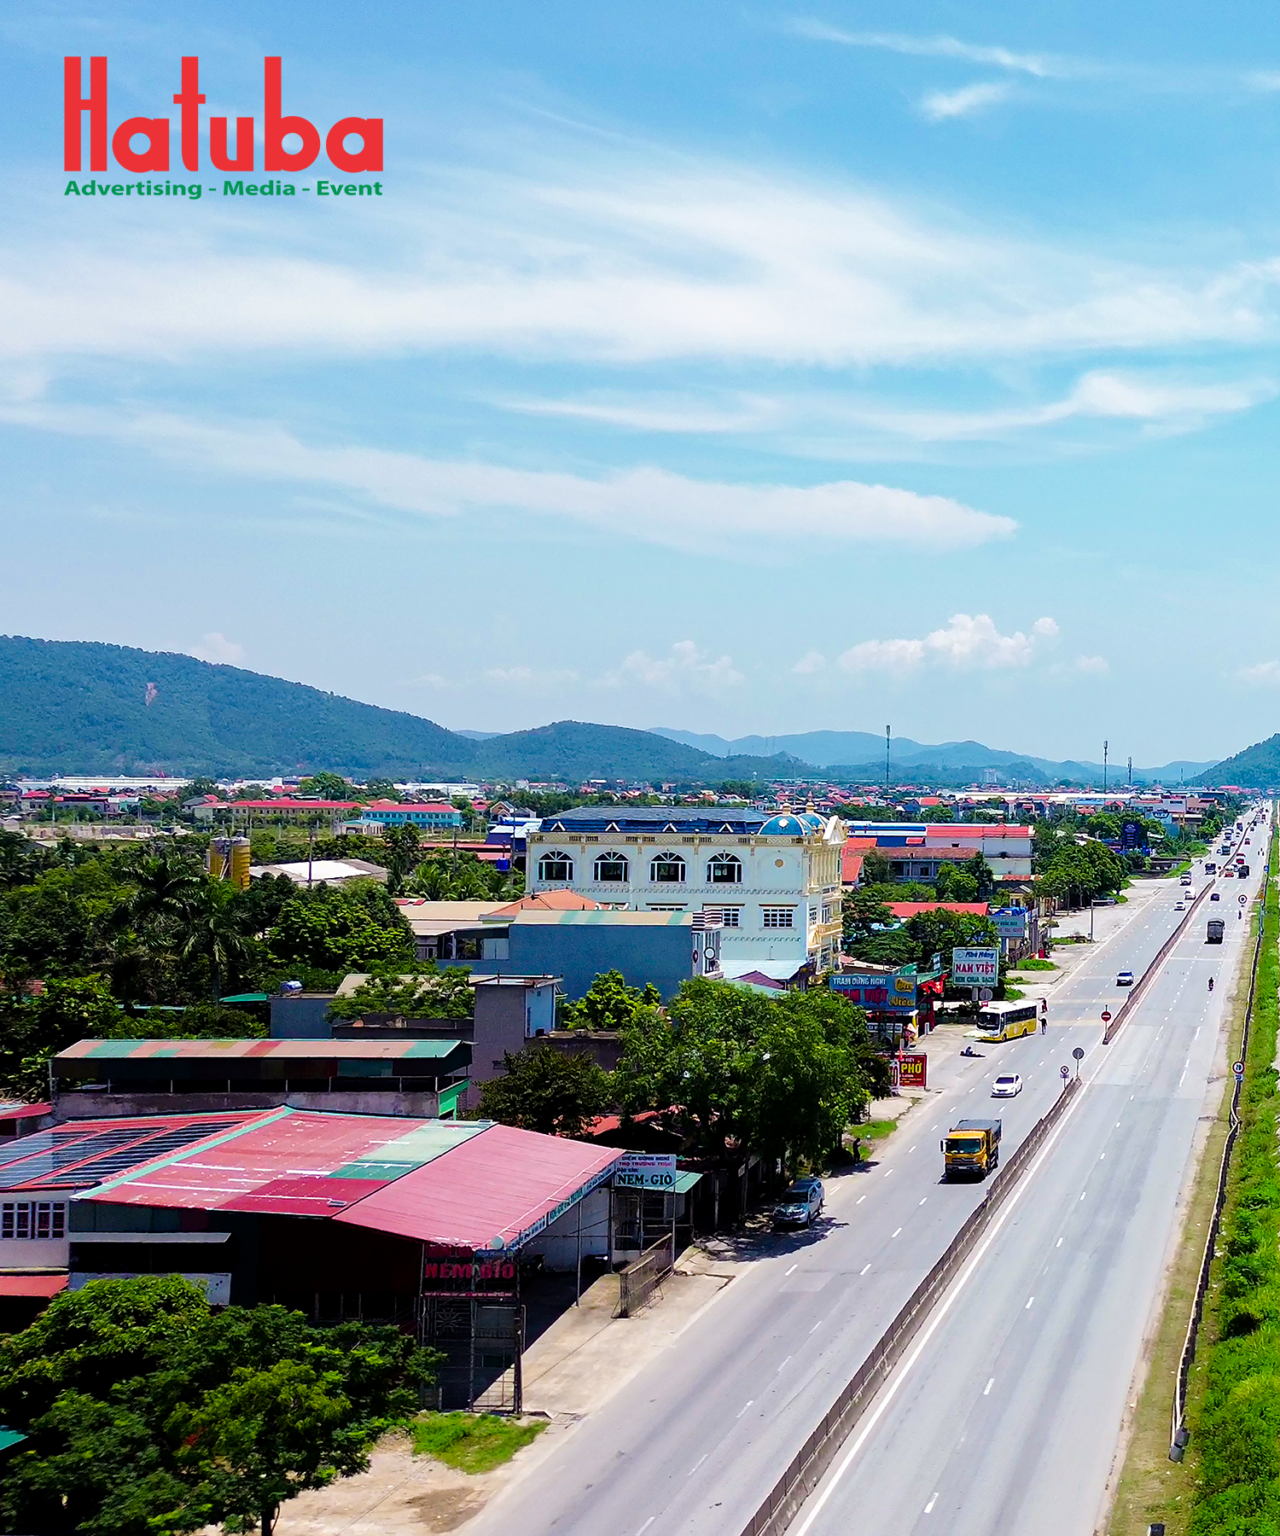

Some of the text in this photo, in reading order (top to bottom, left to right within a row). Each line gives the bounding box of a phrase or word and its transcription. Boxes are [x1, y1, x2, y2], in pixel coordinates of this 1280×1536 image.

[901, 1060, 923, 1074] PHỞ
[617, 1174, 645, 1185] NEM
[650, 1171, 673, 1185] GIÒ
[425, 1263, 473, 1279] NEM
